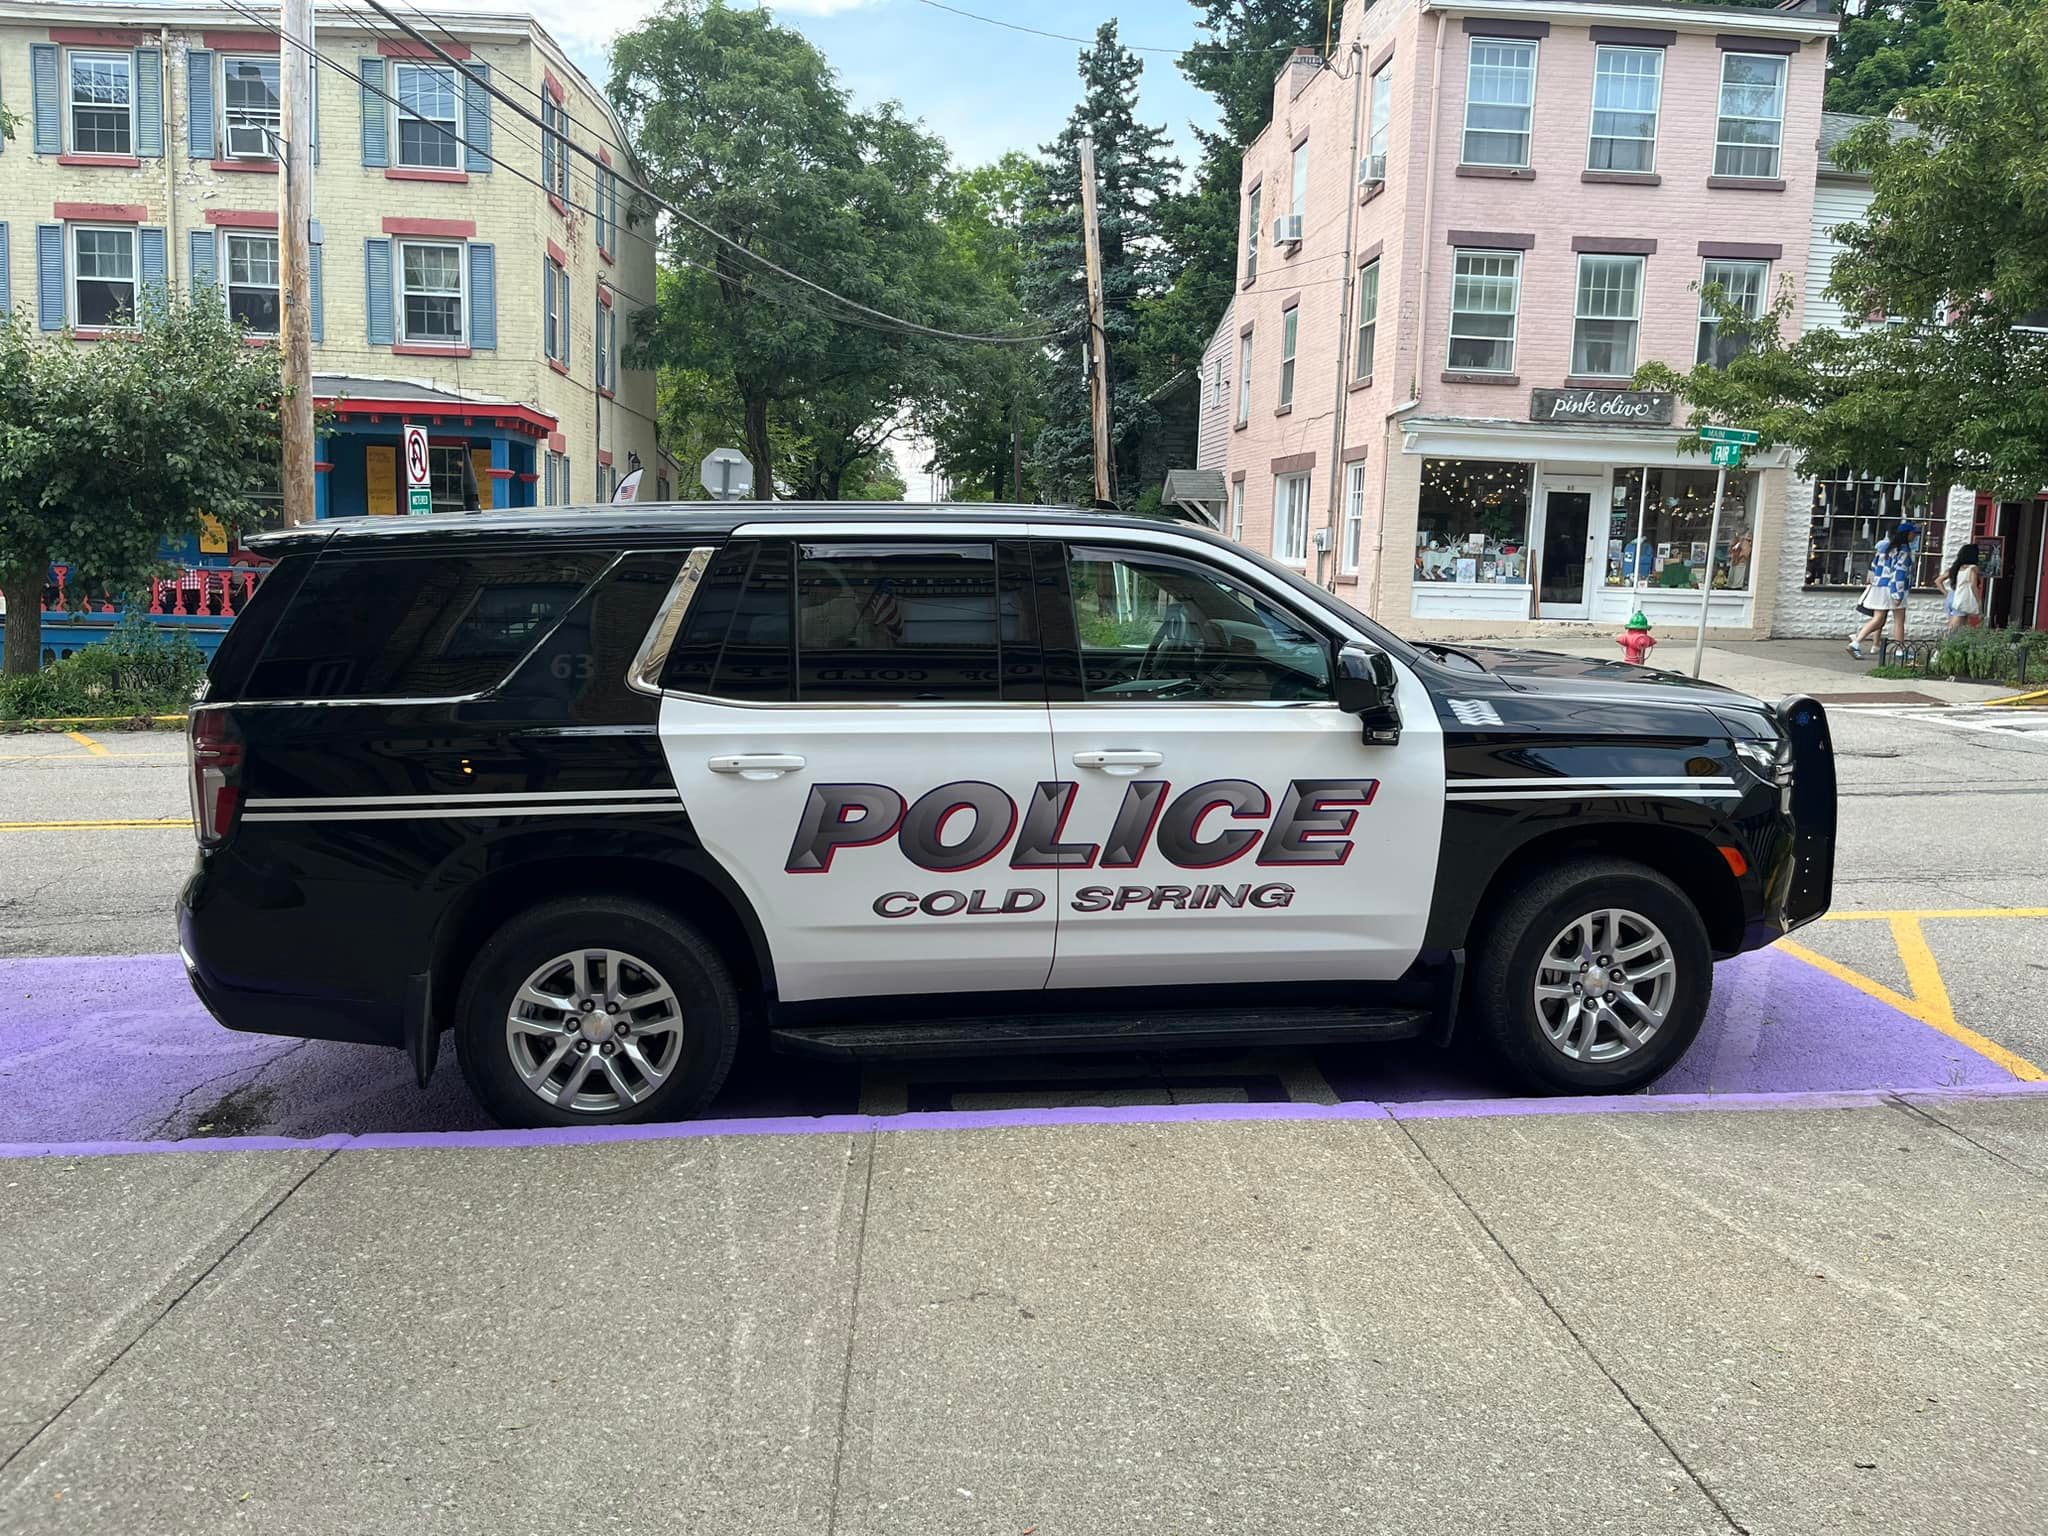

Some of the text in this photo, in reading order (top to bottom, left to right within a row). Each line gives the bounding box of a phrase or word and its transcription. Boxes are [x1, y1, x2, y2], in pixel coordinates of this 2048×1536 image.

[1550, 391, 1649, 418] pink olive
[1707, 429, 1751, 442] MAIN ST
[1714, 445, 1730, 462] FAIR
[551, 654, 594, 679] 63
[784, 779, 1380, 873] POLICE
[872, 882, 1296, 918] COLD SPRING
